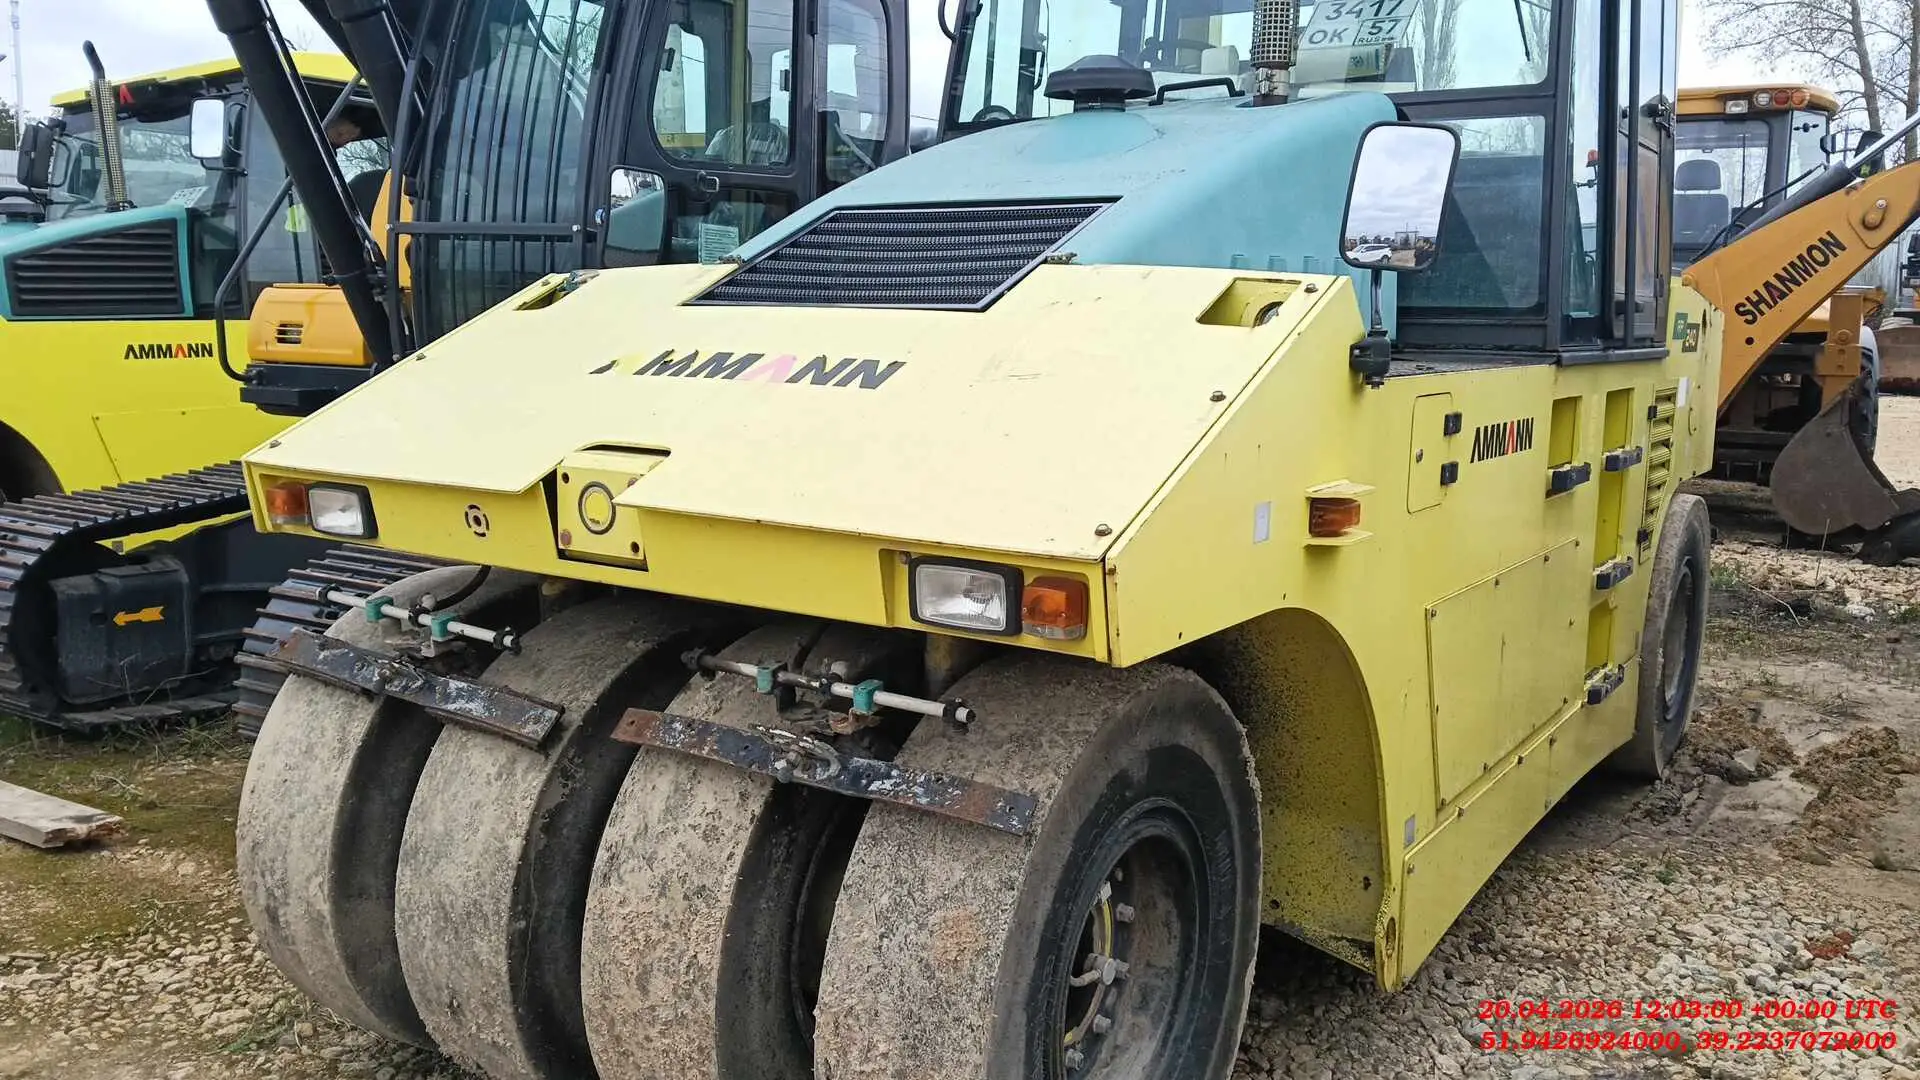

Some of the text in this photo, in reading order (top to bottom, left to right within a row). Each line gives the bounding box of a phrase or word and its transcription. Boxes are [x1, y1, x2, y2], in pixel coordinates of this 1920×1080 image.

[1308, 27, 1350, 44] OK
[1368, 19, 1404, 35] 57
[1734, 230, 1848, 325] SHANMON
[124, 343, 214, 360] AMMANN
[1470, 417, 1534, 464] AMMANN
